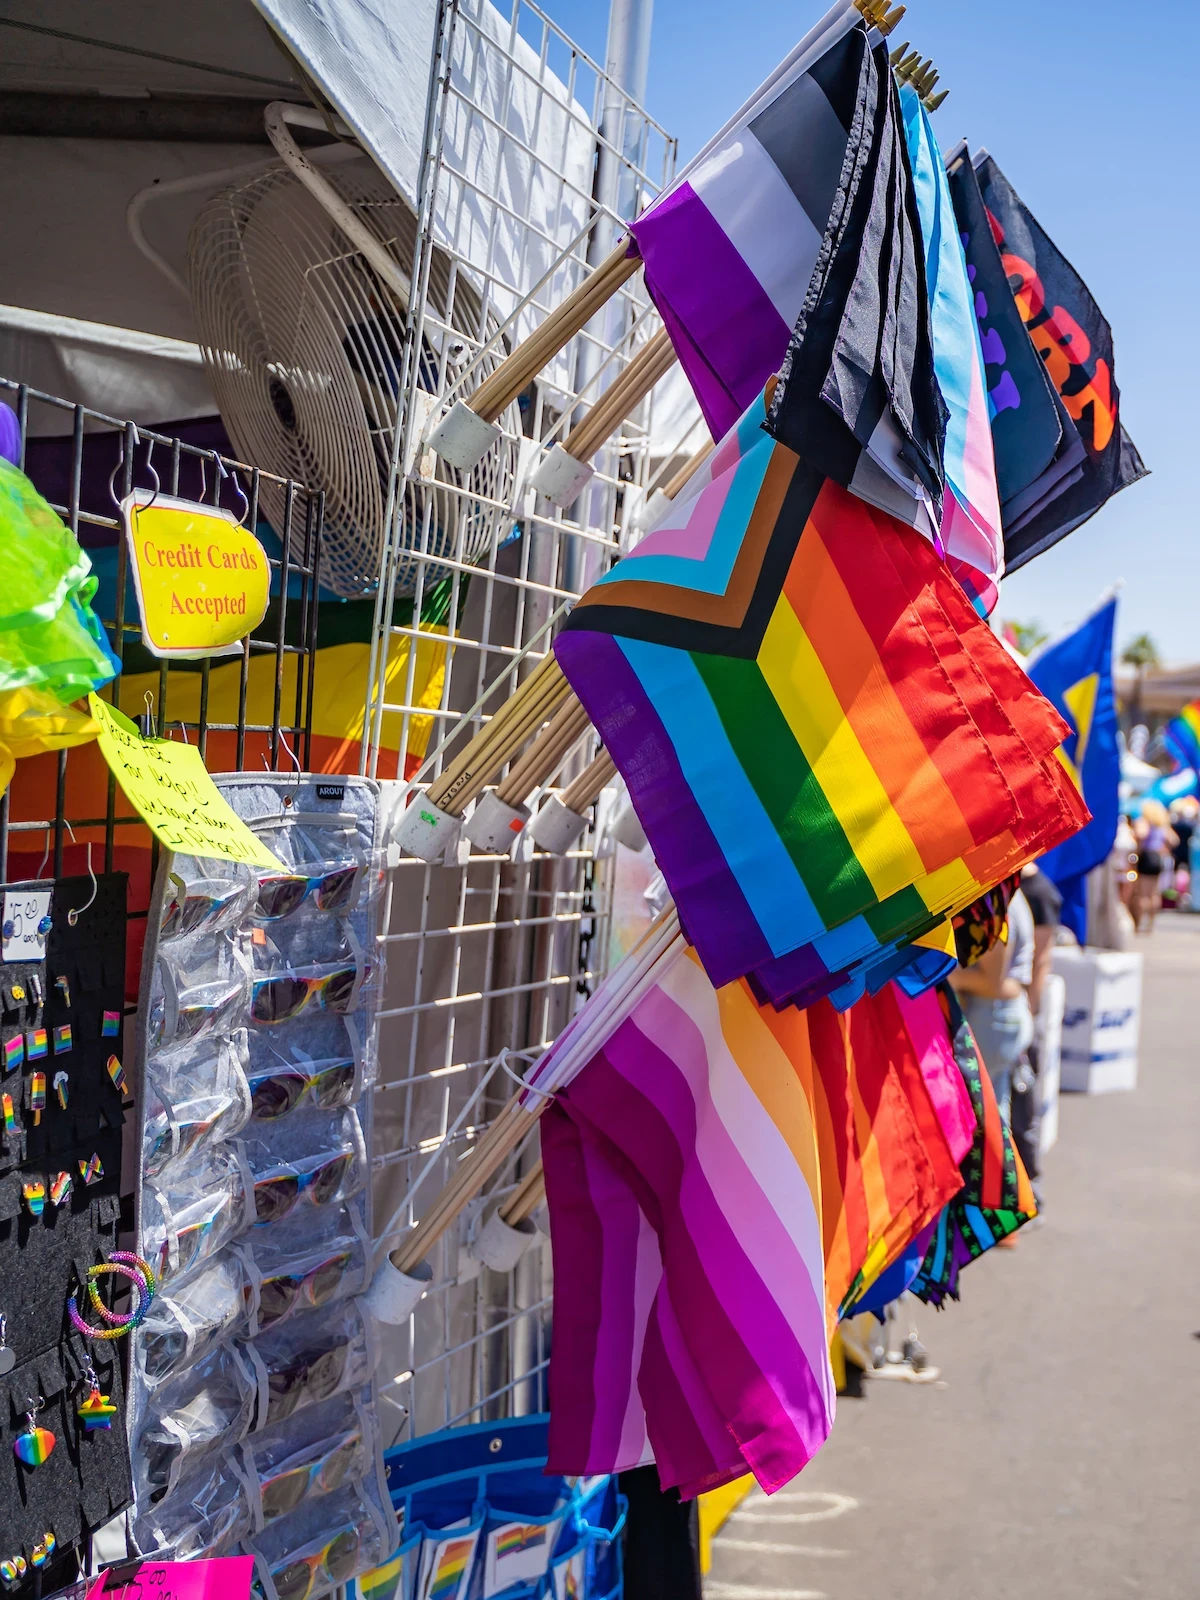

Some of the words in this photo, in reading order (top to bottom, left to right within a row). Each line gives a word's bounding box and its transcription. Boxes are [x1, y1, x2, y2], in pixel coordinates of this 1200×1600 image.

[144, 541, 203, 569] Credit
[207, 545, 258, 570] Cards
[170, 591, 247, 622] Accepted
